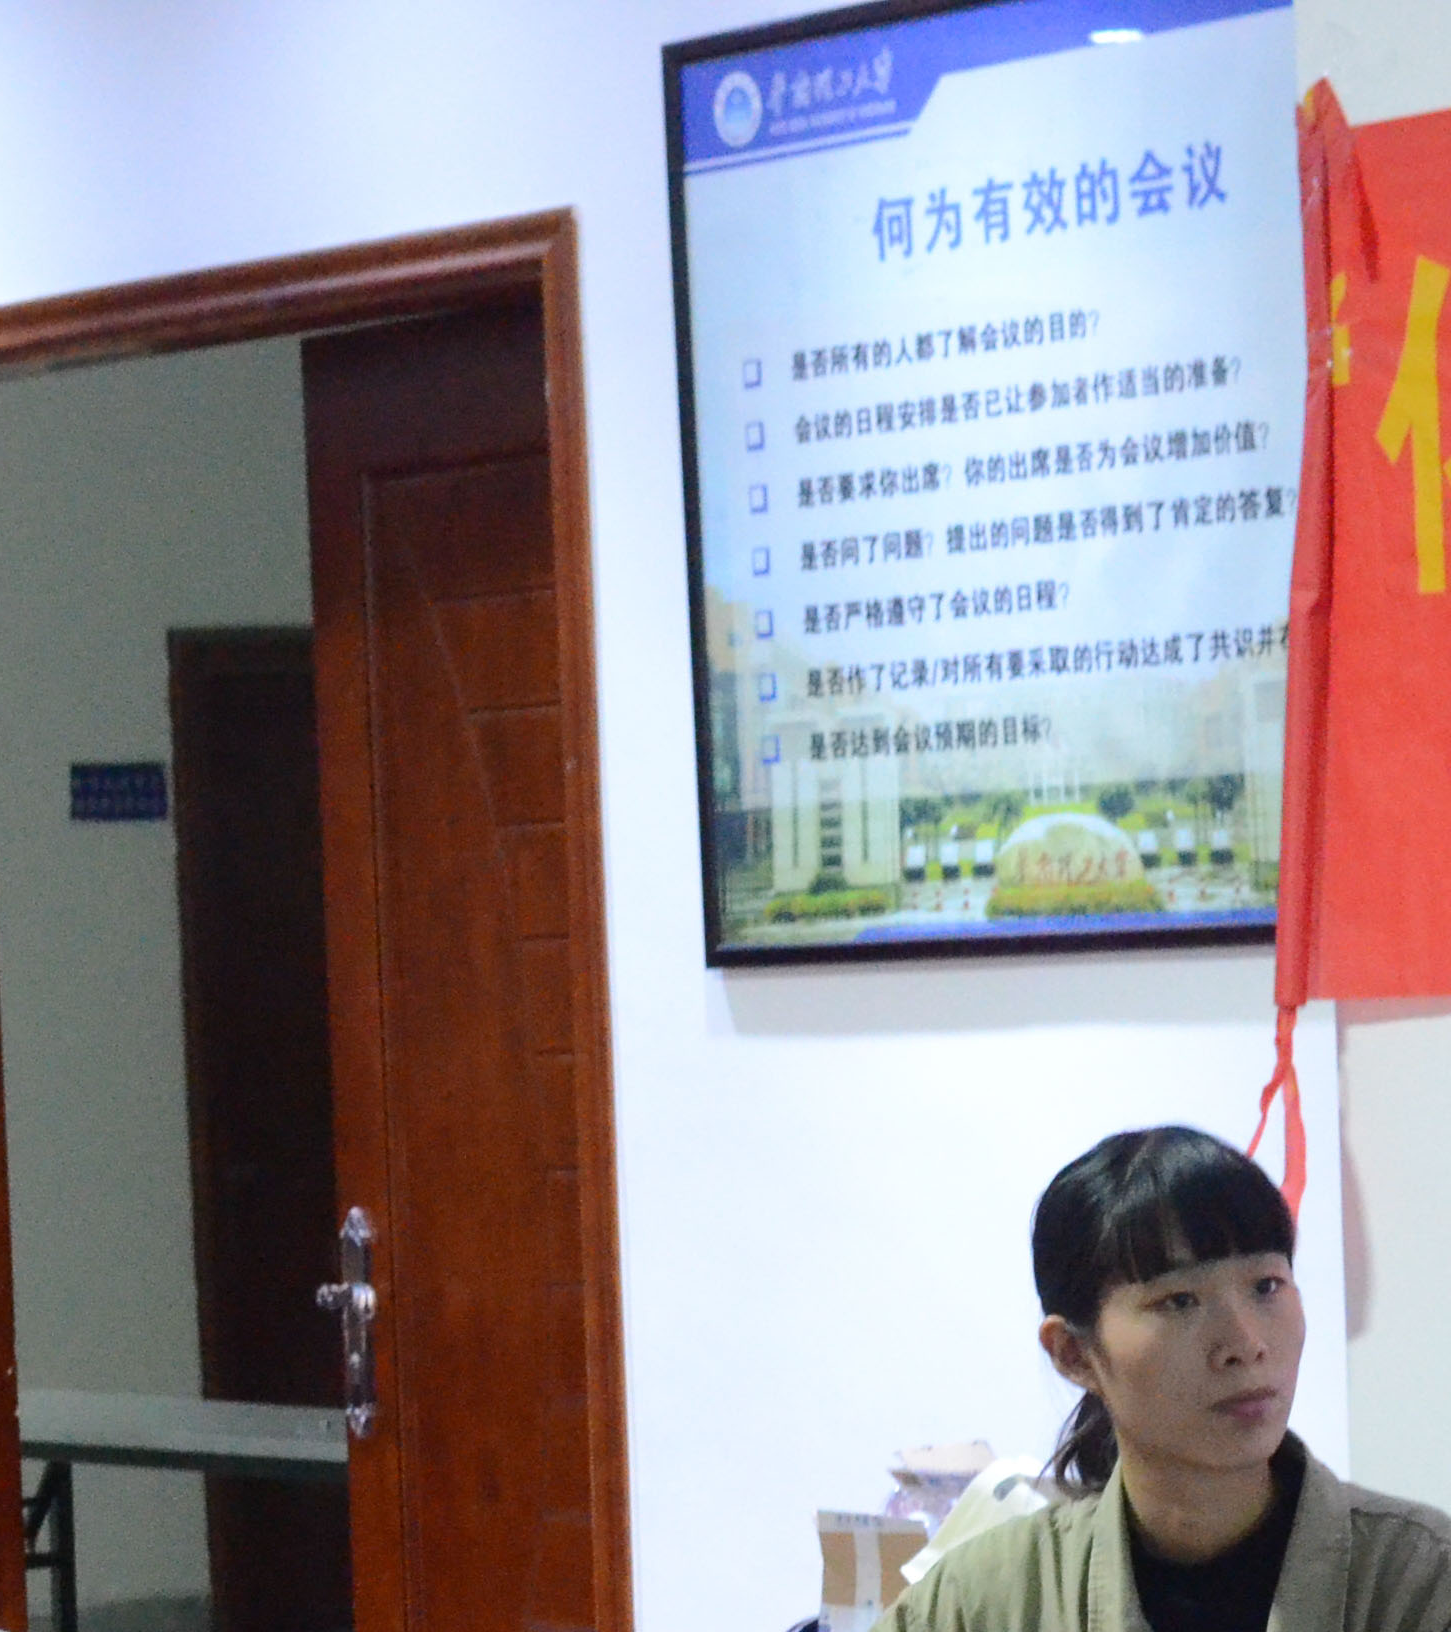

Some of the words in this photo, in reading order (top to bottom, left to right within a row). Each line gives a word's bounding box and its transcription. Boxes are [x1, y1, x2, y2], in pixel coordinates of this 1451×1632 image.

[872, 140, 1228, 262] 何为有效的会议
